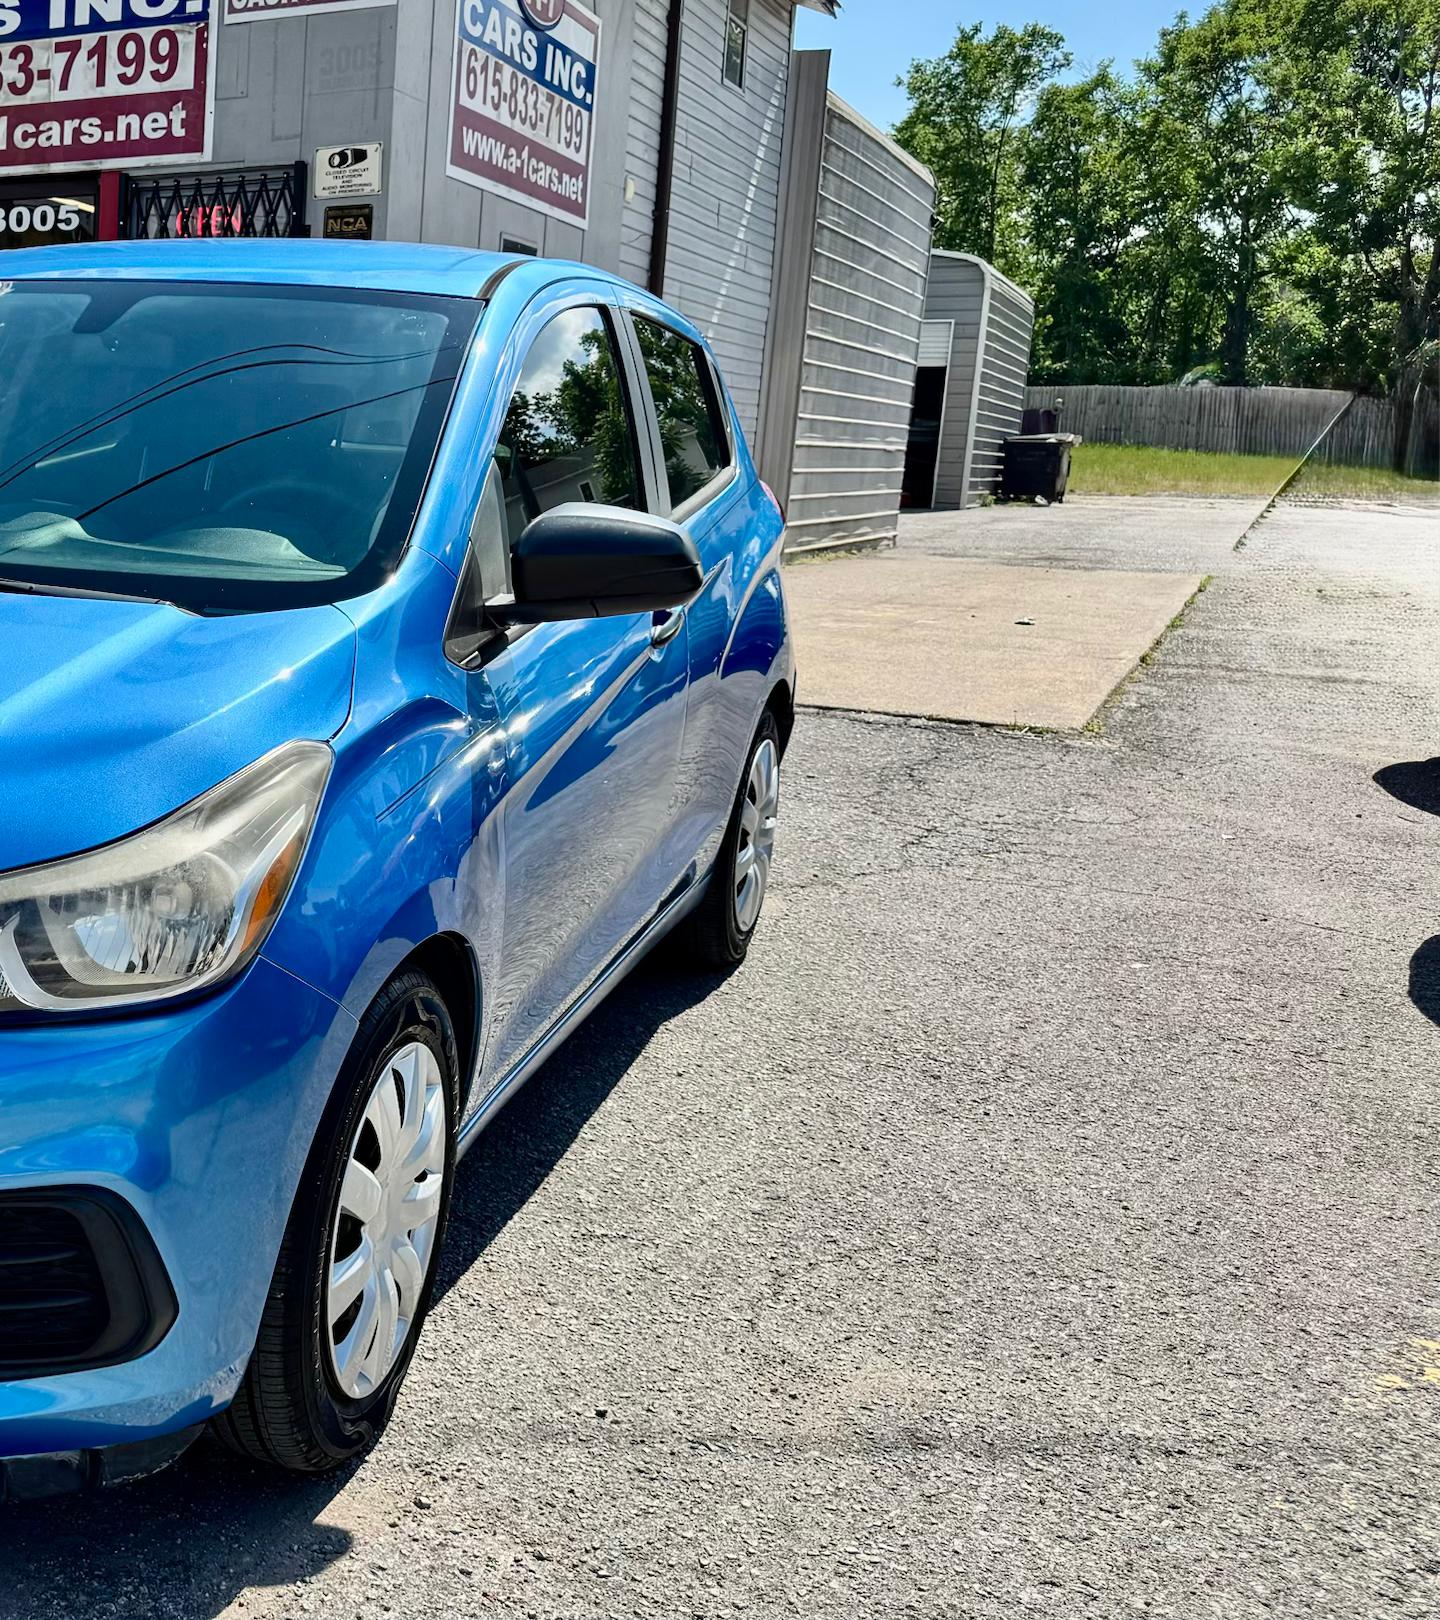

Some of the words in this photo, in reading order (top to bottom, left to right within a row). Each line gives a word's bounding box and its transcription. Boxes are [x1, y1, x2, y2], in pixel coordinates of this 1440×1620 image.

[463, 0, 538, 71] CARS
[544, 43, 593, 105] INC.
[465, 47, 583, 154] 615-833-7199
[462, 125, 583, 204] www.a-1cars.net
[326, 216, 368, 232] NCA
